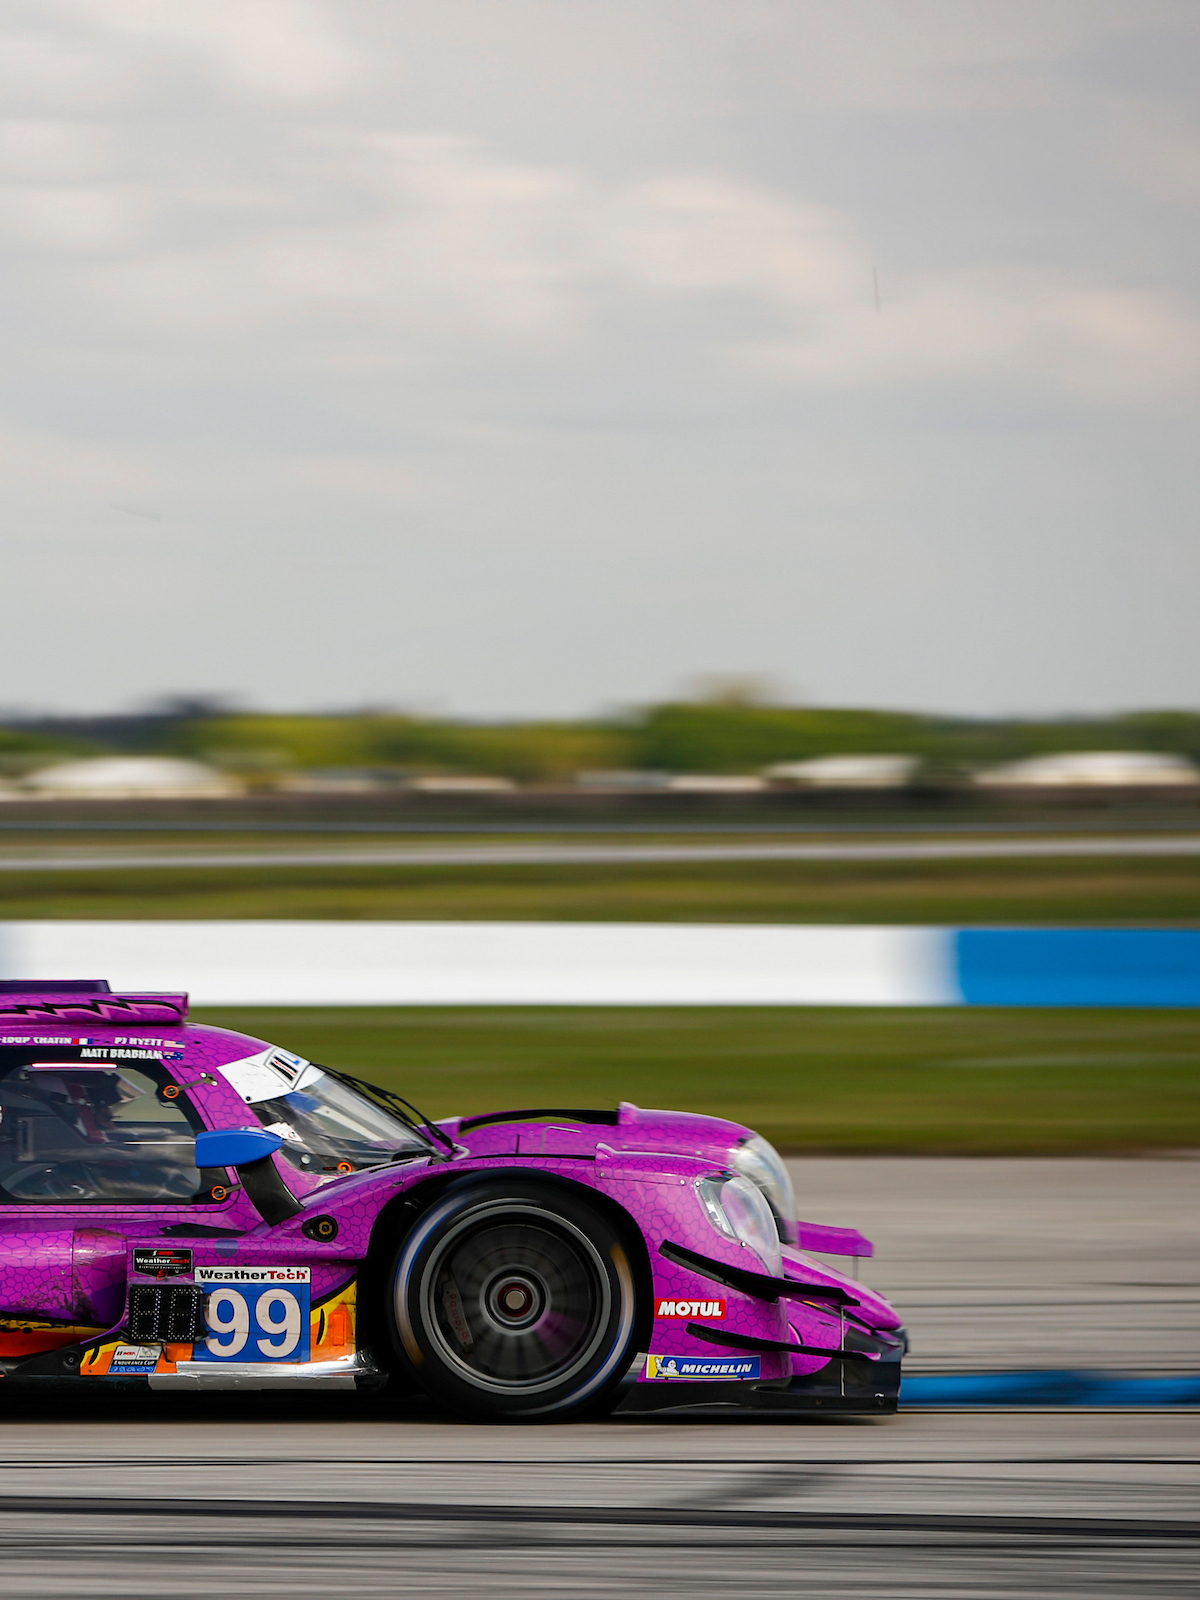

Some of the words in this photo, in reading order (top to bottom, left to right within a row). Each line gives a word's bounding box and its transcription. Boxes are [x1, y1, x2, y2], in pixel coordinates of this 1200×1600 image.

[114, 1037, 127, 1045] PJ
[80, 1048, 109, 1058] MATT
[110, 1048, 164, 1060] BRABHAM
[199, 1269, 306, 1280] WeatherTech
[657, 1301, 722, 1316] MOTUL
[204, 1287, 301, 1358] 99
[681, 1364, 753, 1374] MICHELIN
